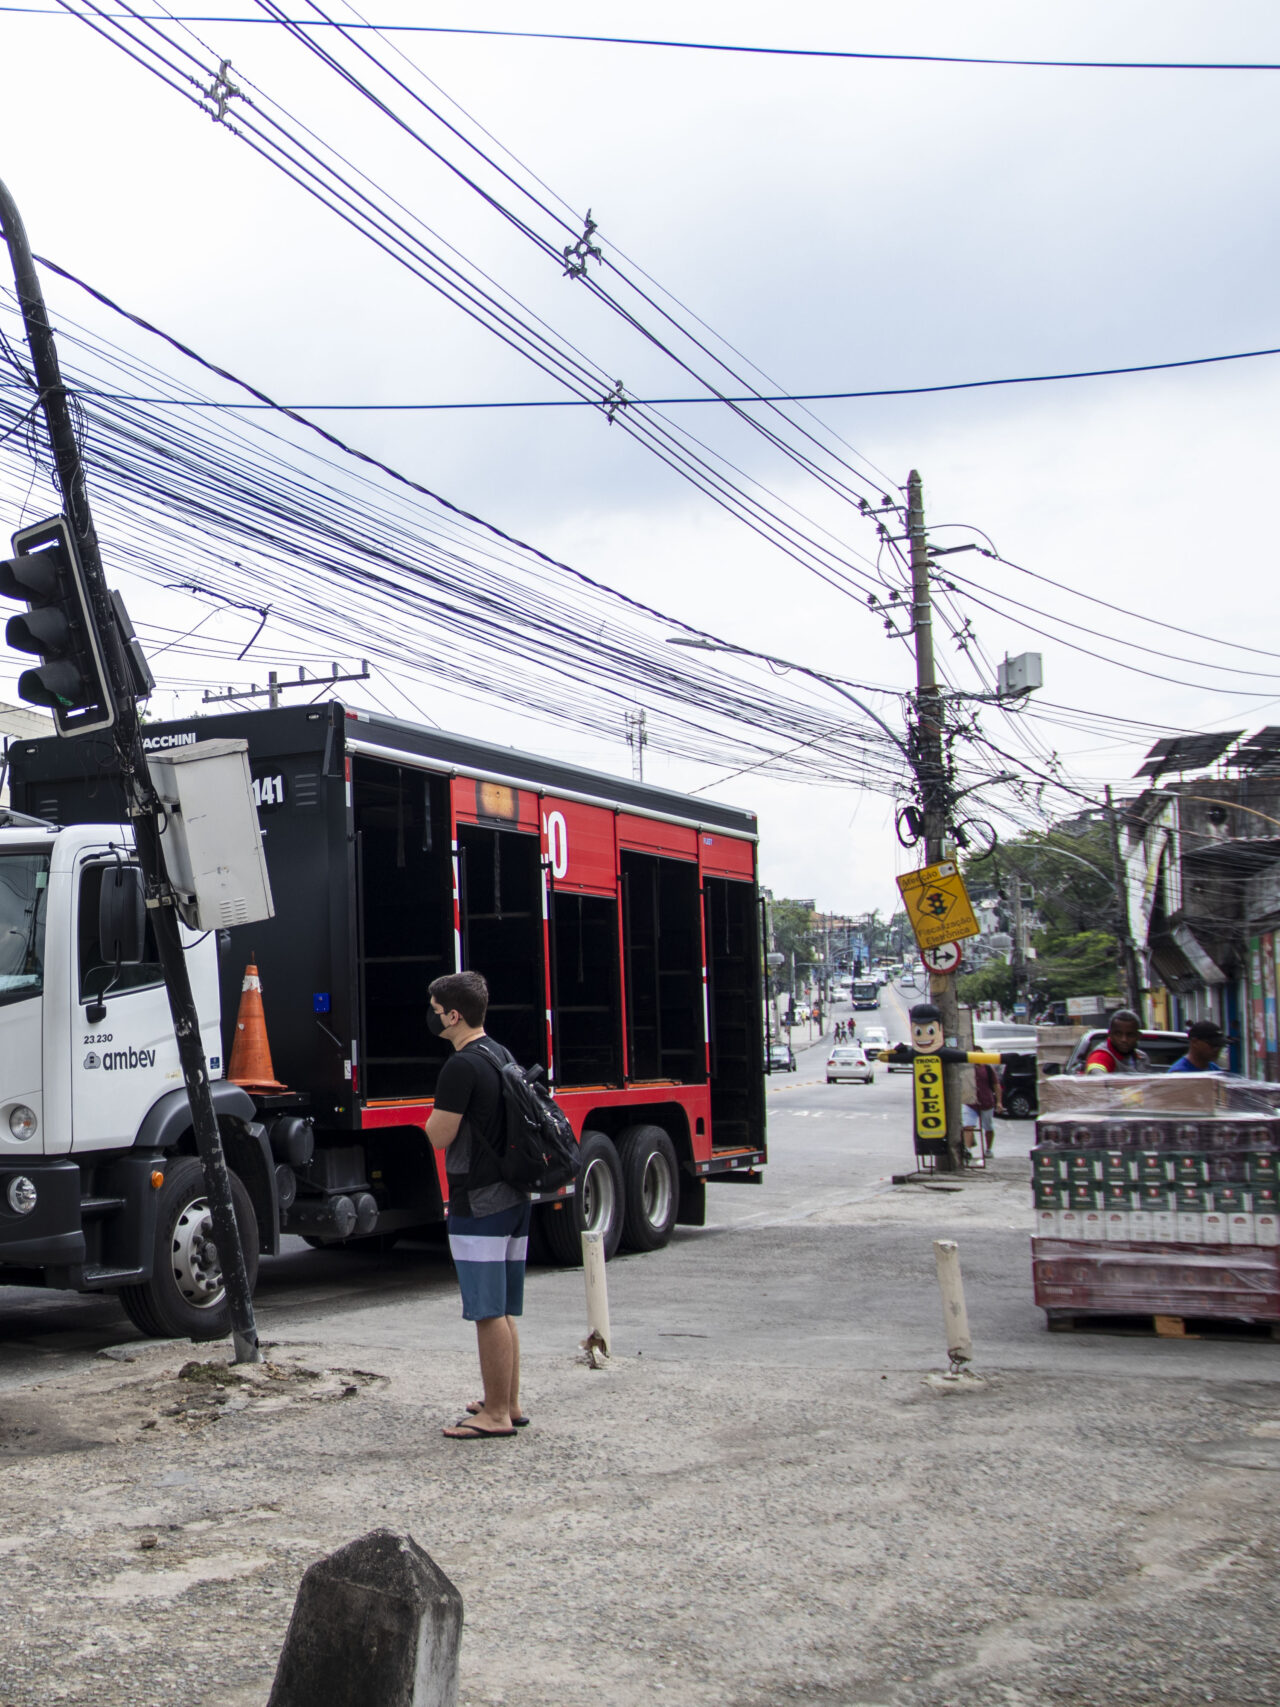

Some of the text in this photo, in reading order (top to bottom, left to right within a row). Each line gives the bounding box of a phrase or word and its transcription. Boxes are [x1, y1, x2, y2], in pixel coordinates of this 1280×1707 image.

[83, 1033, 114, 1045] 23.230
[102, 1045, 156, 1071] ambev
[918, 1068, 942, 1129] ÓLEO
